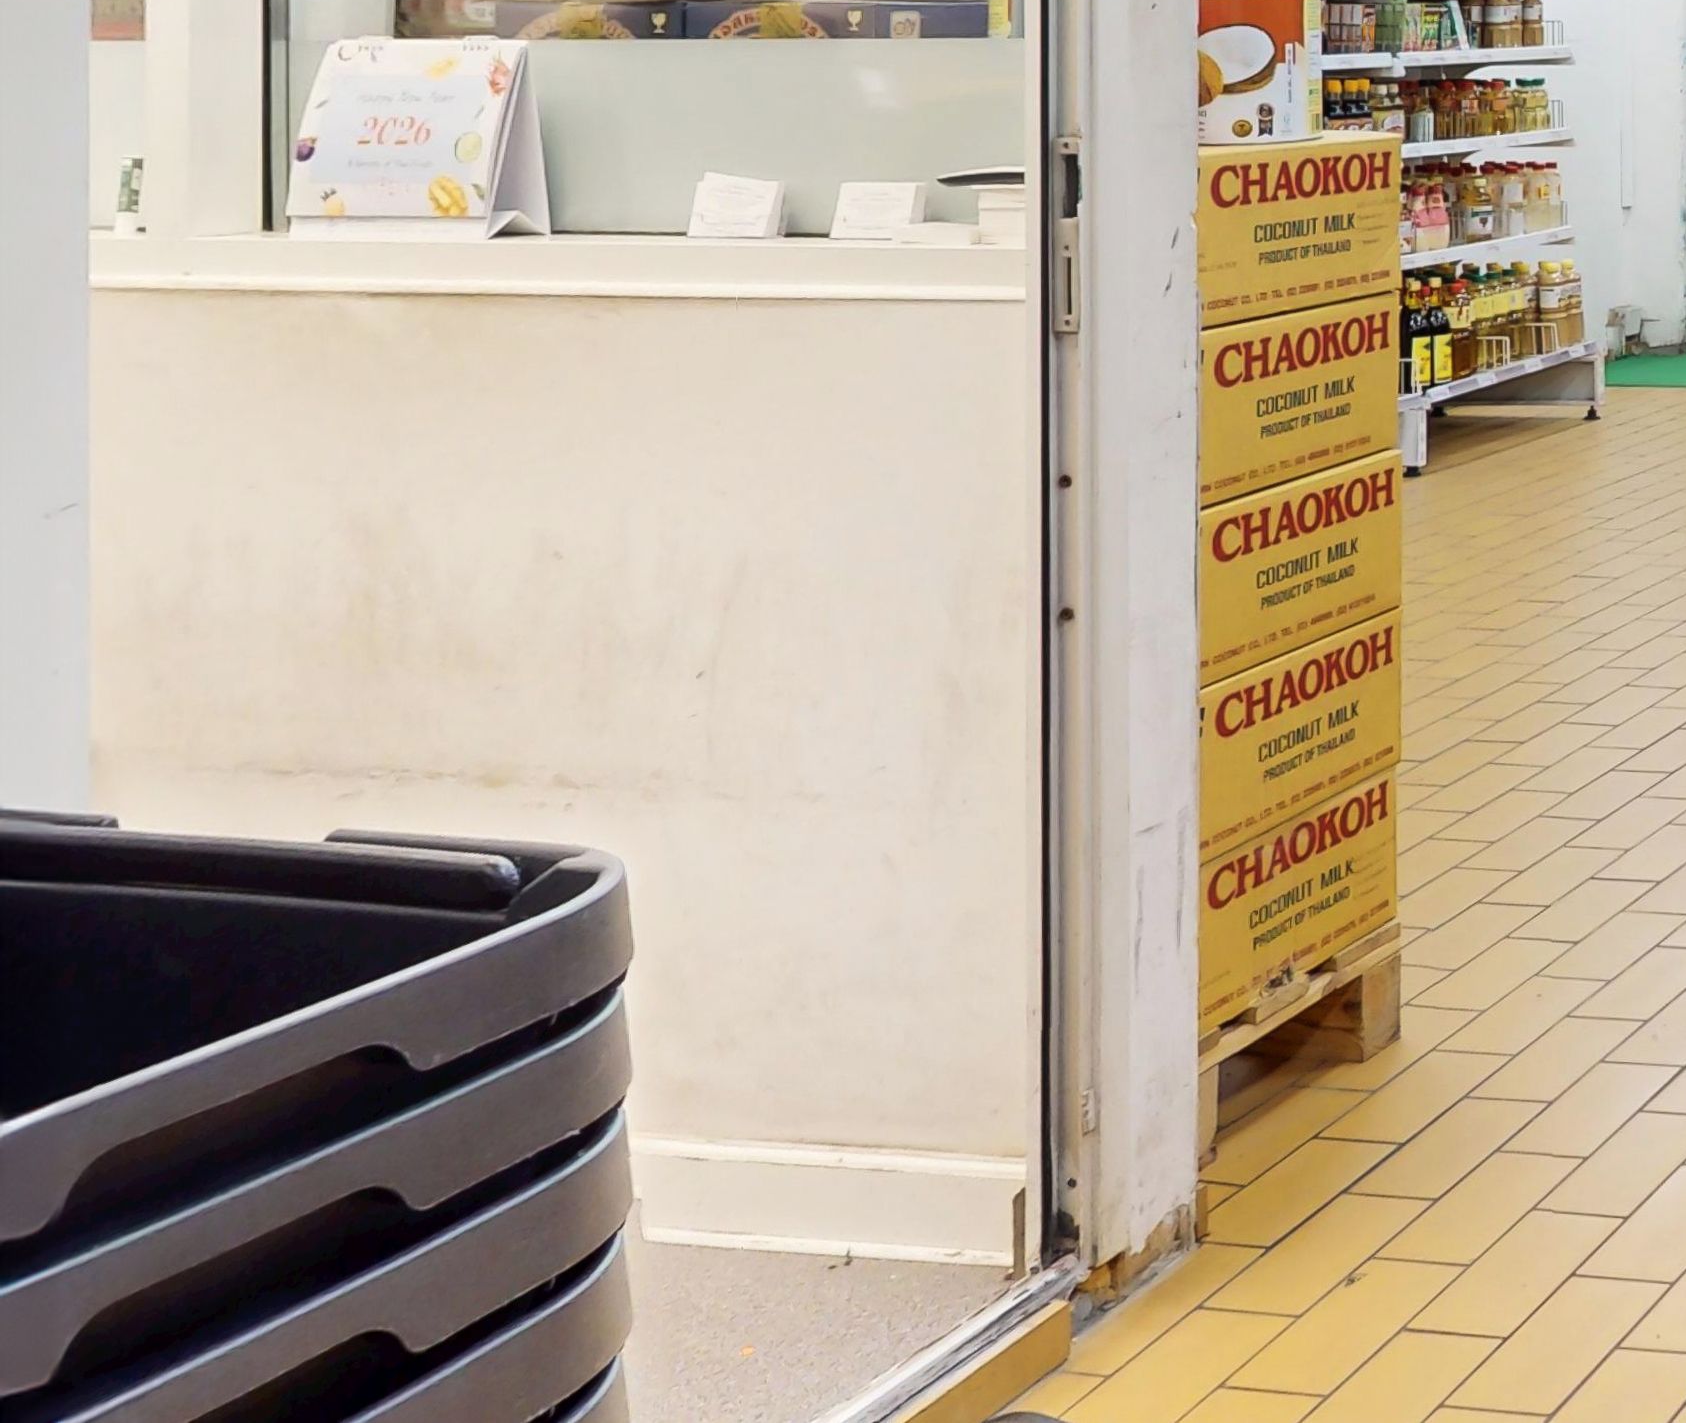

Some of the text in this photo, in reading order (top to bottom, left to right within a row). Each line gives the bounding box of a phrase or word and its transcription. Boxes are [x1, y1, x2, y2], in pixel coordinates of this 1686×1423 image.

[357, 115, 432, 146] 2026
[1211, 151, 1392, 208] CHAOKOH
[1254, 213, 1356, 244] COCONUT MILK
[1258, 239, 1352, 266] PRODUCT OF THAILAND
[1214, 311, 1390, 388] CHAOKOH
[1256, 376, 1356, 418] COCONUT MILK
[1260, 402, 1352, 439] PRODUCT OF THAILAND
[1212, 468, 1394, 563] CHAOKOH
[1256, 537, 1359, 590] COCONUT MILK
[1261, 564, 1356, 610] PRODUCT OF THAILAND
[1215, 625, 1394, 738] CHAOKOH
[1258, 699, 1360, 763] COCONUT MILK
[1263, 753, 1304, 783] PRODUCT
[1305, 749, 1316, 764] OF
[1317, 728, 1356, 755] THAILAND
[1207, 780, 1389, 910] CHAOKOH
[1250, 859, 1354, 930] COCONUT MILK
[1253, 917, 1293, 951] PRODUCT
[1294, 911, 1306, 928] OF
[1309, 886, 1351, 919] THAILAND
